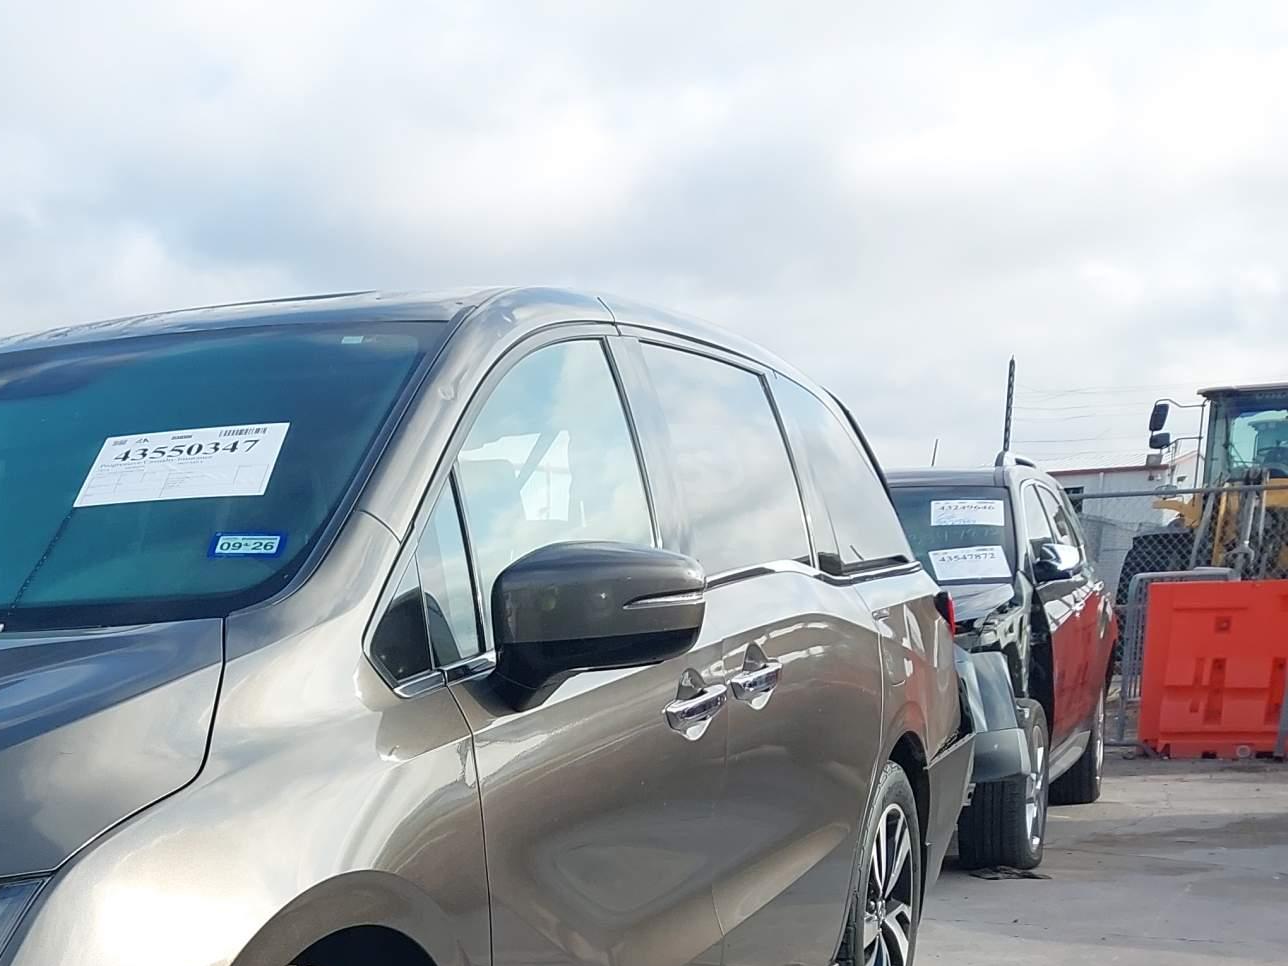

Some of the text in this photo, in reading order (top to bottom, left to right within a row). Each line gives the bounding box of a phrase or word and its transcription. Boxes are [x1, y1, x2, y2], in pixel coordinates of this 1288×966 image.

[113, 438, 261, 462] 43550347
[219, 541, 275, 551] 09 26
